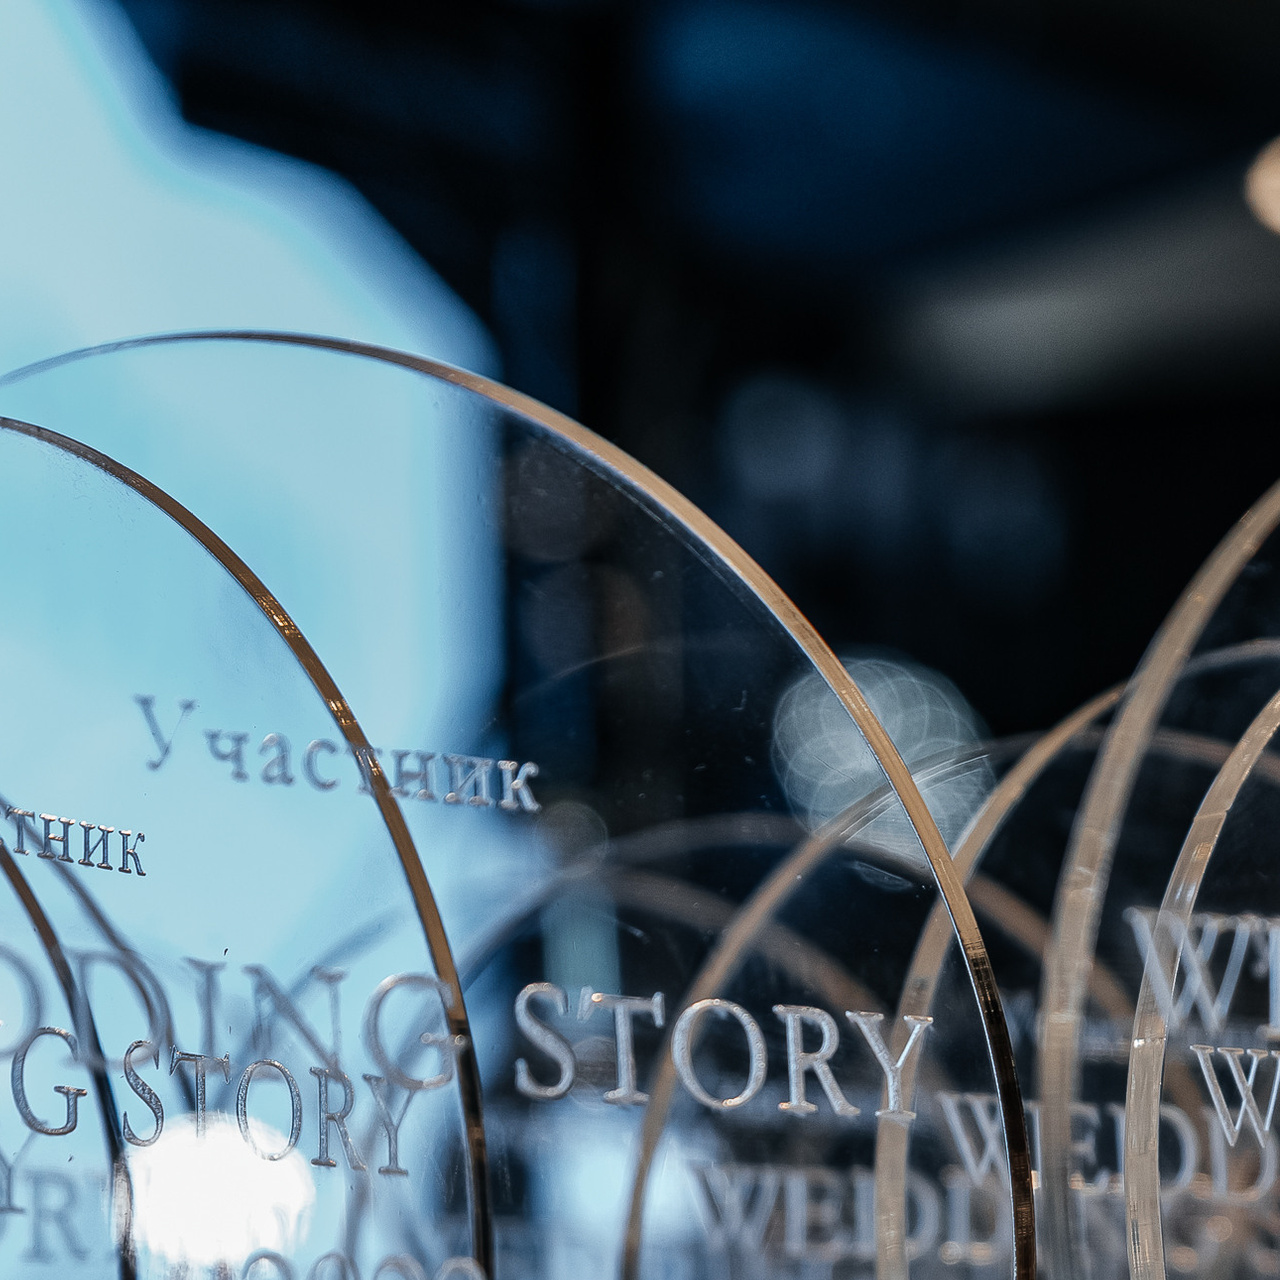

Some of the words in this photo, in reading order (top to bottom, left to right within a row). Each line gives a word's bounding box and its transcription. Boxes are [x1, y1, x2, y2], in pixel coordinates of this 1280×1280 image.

[4, 804, 147, 876] тник
[121, 1040, 412, 1175] STORY
[514, 982, 935, 1119] STORY
